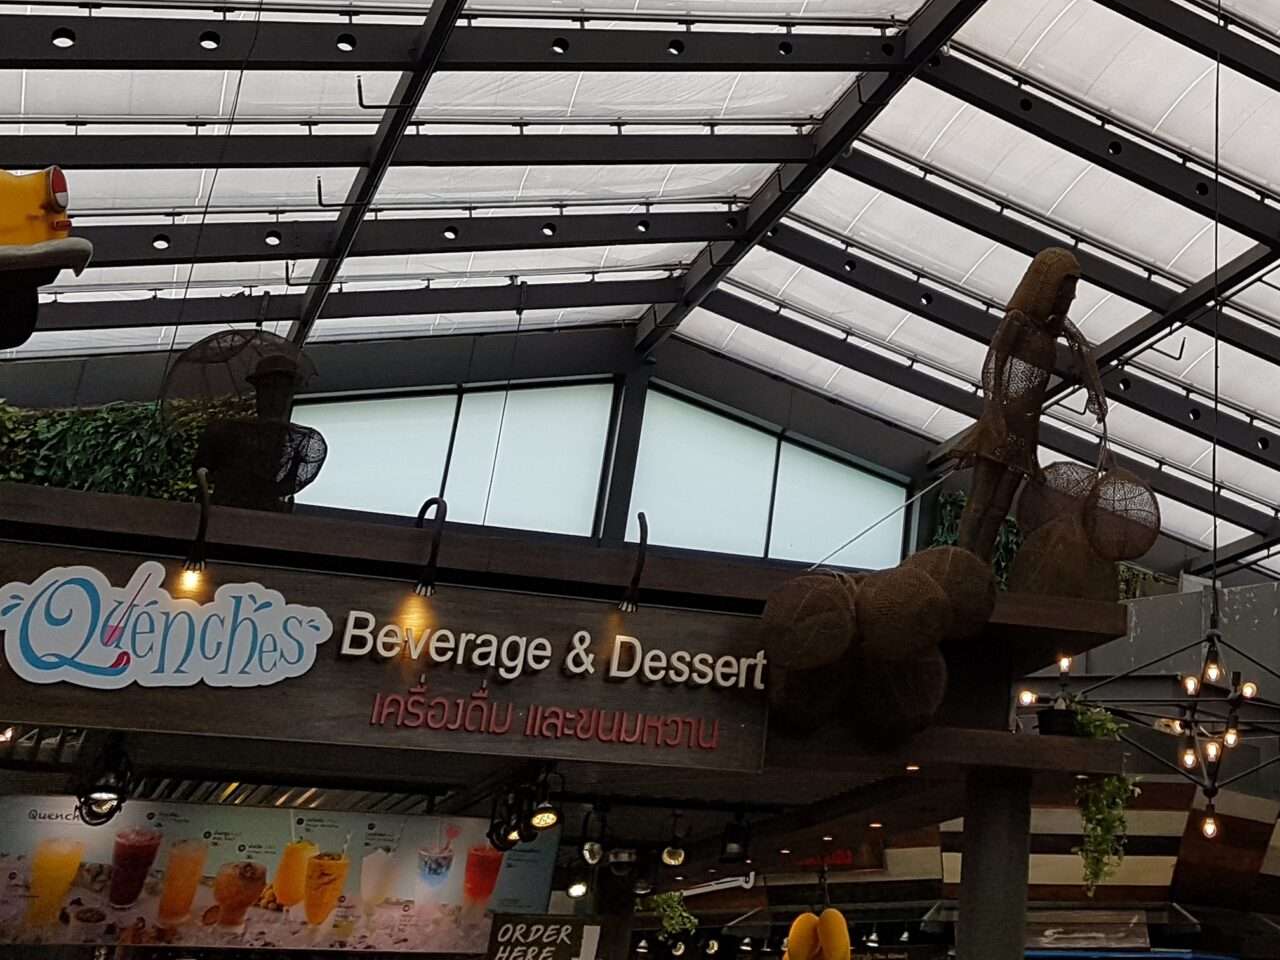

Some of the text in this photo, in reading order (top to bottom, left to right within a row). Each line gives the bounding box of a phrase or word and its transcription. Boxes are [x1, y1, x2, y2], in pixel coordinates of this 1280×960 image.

[340, 610, 768, 690] Beverage & Dessert
[370, 673, 720, 750] เครื่องดื่ม และขนมหวาน
[28, 805, 80, 821] Quench
[496, 923, 573, 945] ORDER
[494, 945, 557, 960] HERE
